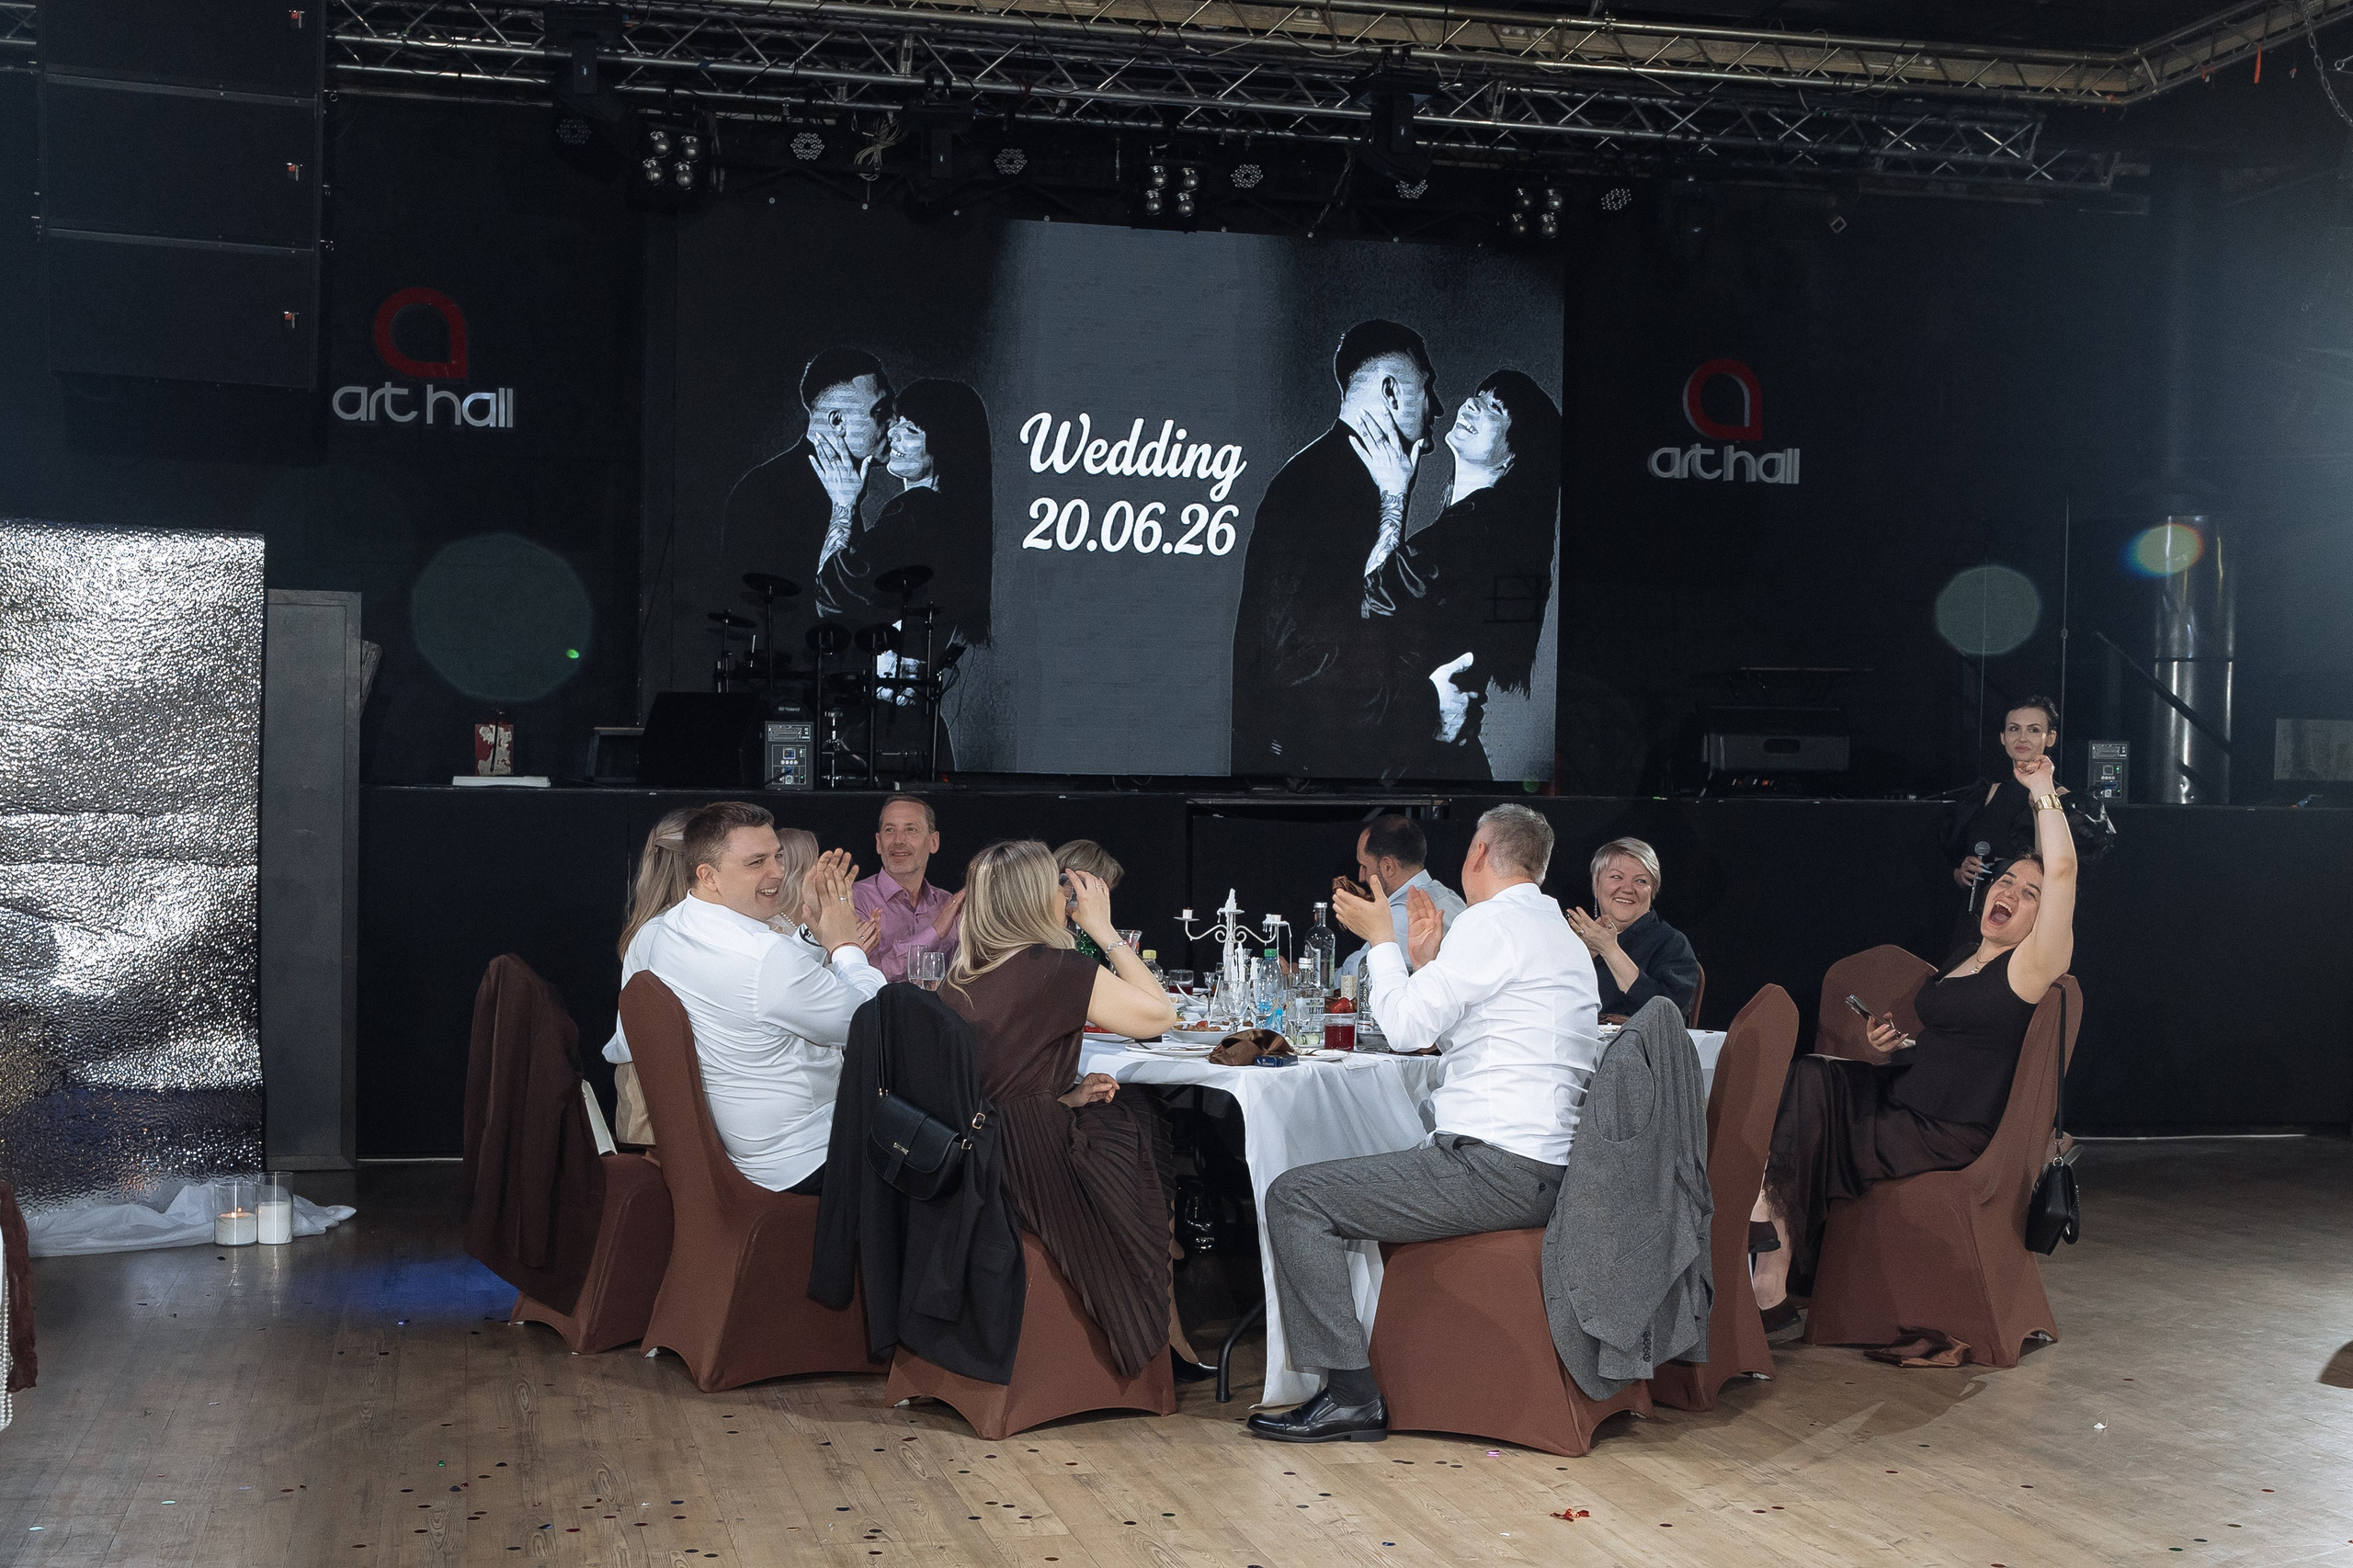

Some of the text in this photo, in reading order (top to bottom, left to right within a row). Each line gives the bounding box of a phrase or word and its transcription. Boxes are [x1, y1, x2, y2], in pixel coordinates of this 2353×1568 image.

[332, 381, 514, 428] art hall
[1019, 412, 1247, 502] Wedding
[1647, 443, 1800, 484] art hall
[1022, 497, 1239, 556] 20.06.26
